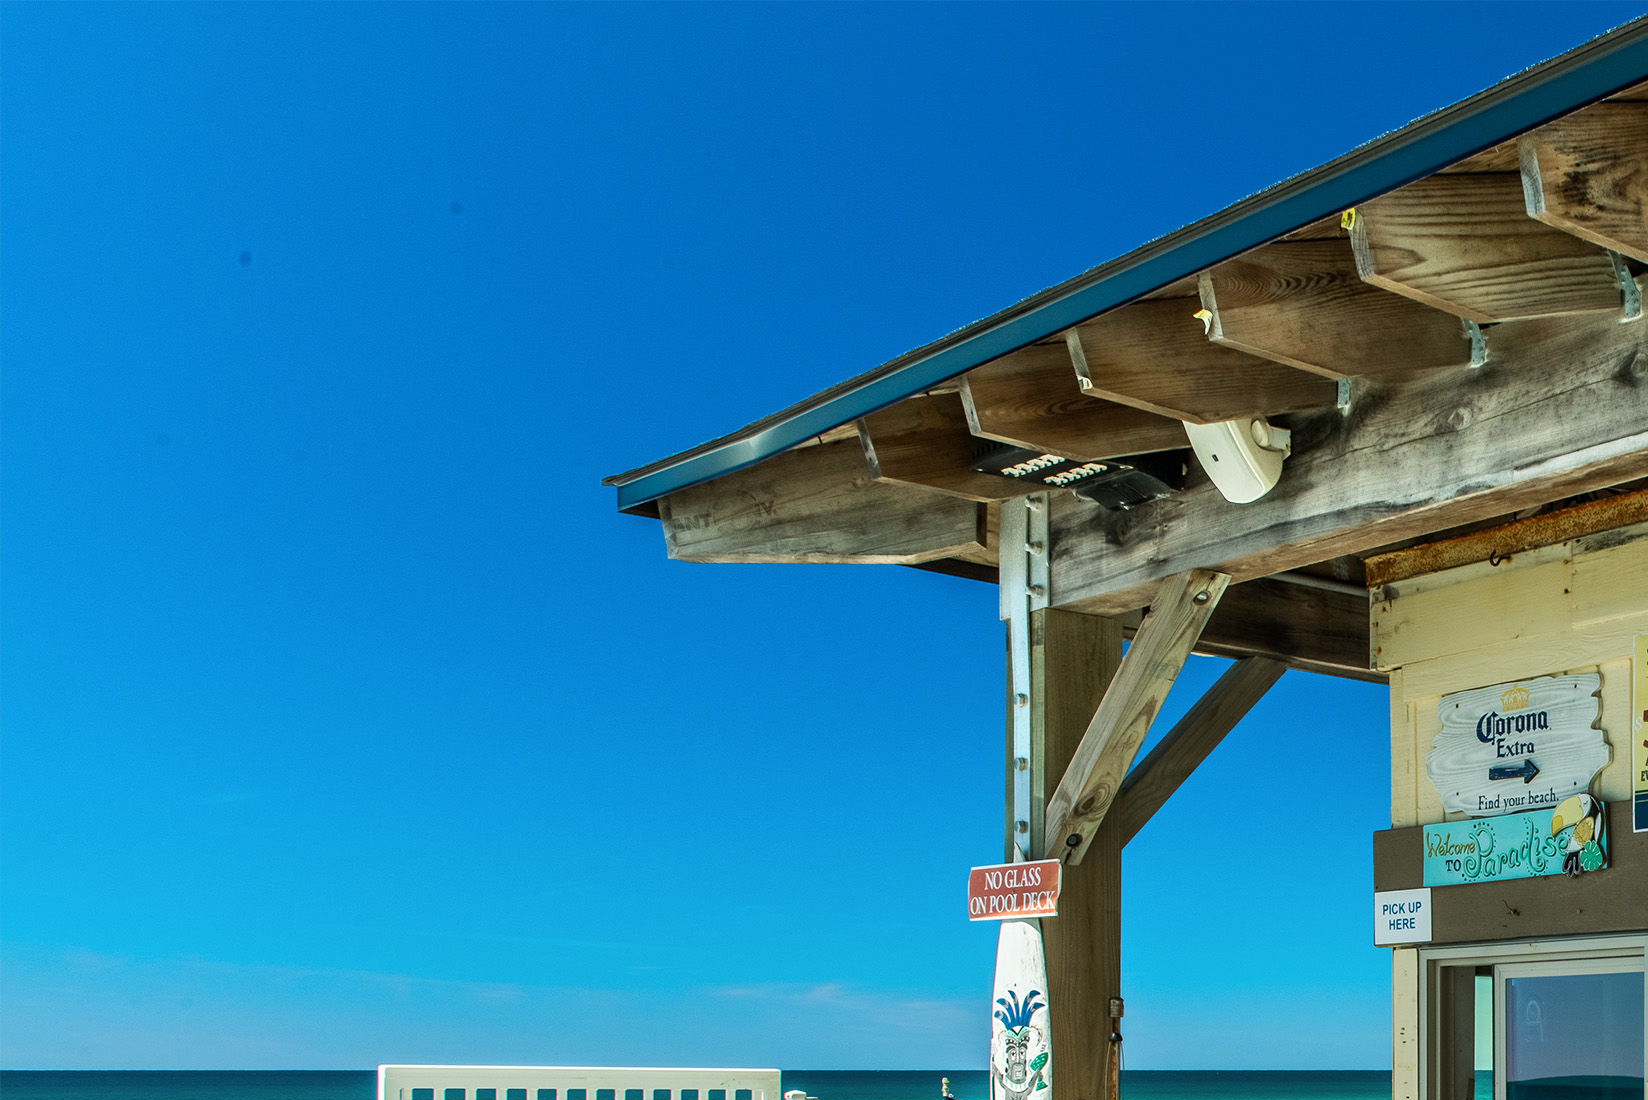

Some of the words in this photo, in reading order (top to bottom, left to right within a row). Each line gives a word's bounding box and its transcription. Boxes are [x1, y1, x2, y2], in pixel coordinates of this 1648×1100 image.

[1476, 709, 1549, 745] Corona
[1495, 739, 1535, 759] Extra
[1478, 793, 1501, 810] Find
[1503, 794, 1525, 808] your
[1527, 789, 1560, 805] beach.
[984, 871, 1003, 890] NO
[1004, 868, 1041, 887] GLASS
[970, 897, 987, 915] ON
[990, 894, 1020, 913] POOL
[1022, 891, 1055, 910] DECK
[1383, 903, 1406, 915] PICK
[1408, 902, 1422, 914] UP
[1389, 918, 1416, 931] HERE
